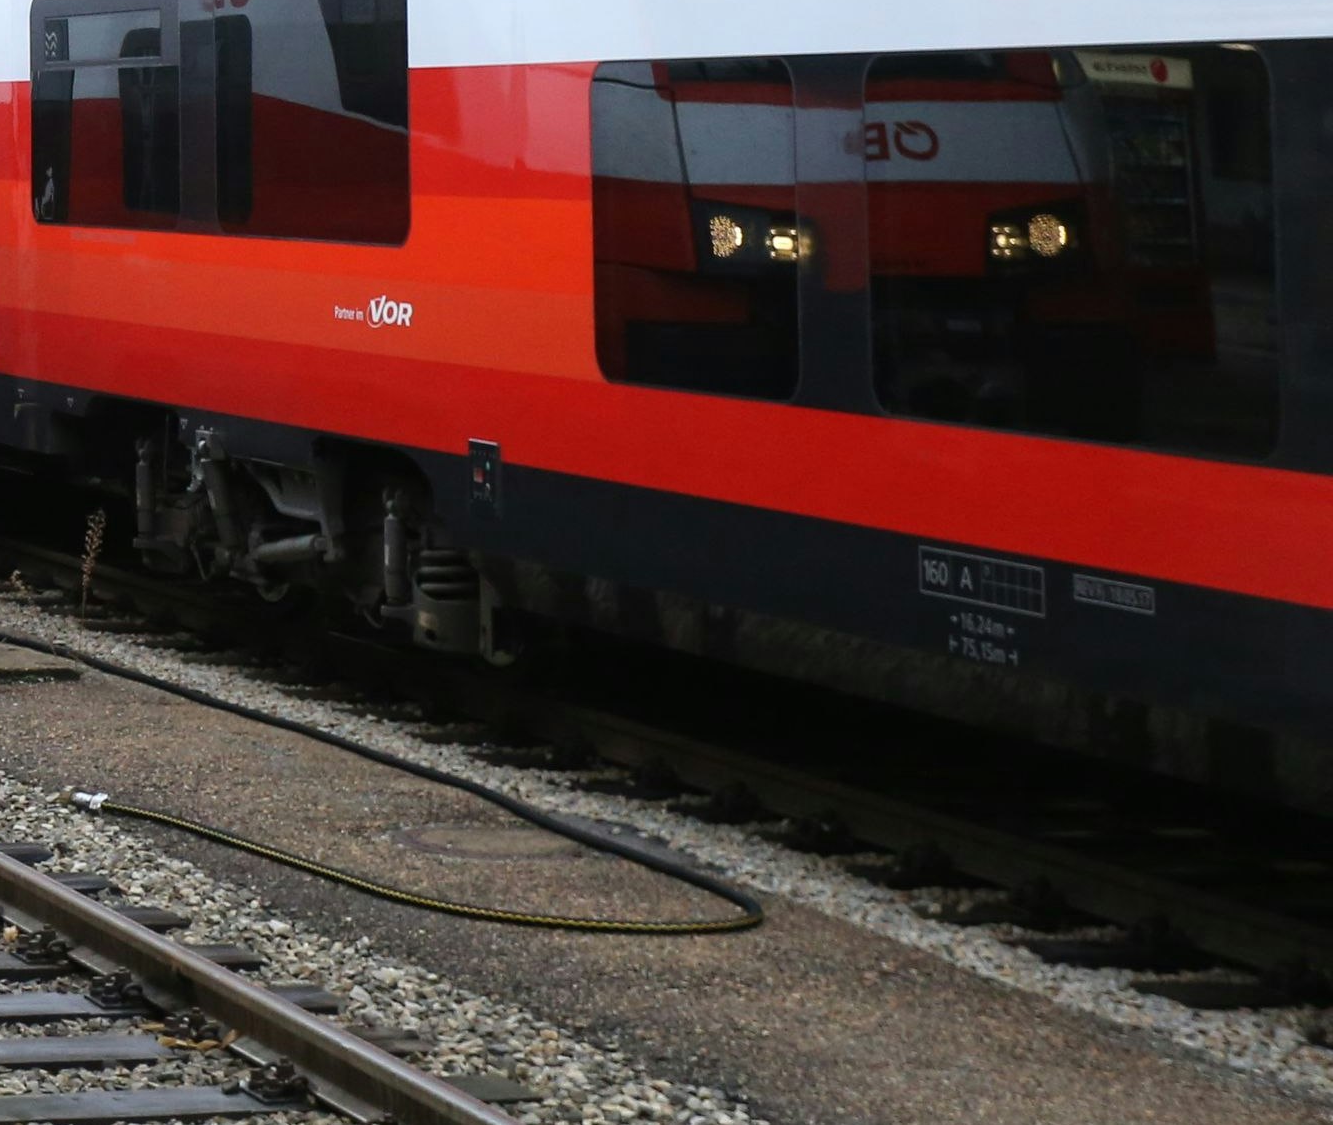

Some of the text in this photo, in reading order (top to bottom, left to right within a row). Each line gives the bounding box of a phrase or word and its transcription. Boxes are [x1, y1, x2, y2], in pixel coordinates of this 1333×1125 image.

[369, 294, 413, 327] VOR
[922, 558, 949, 587] 160
[959, 565, 974, 592] A
